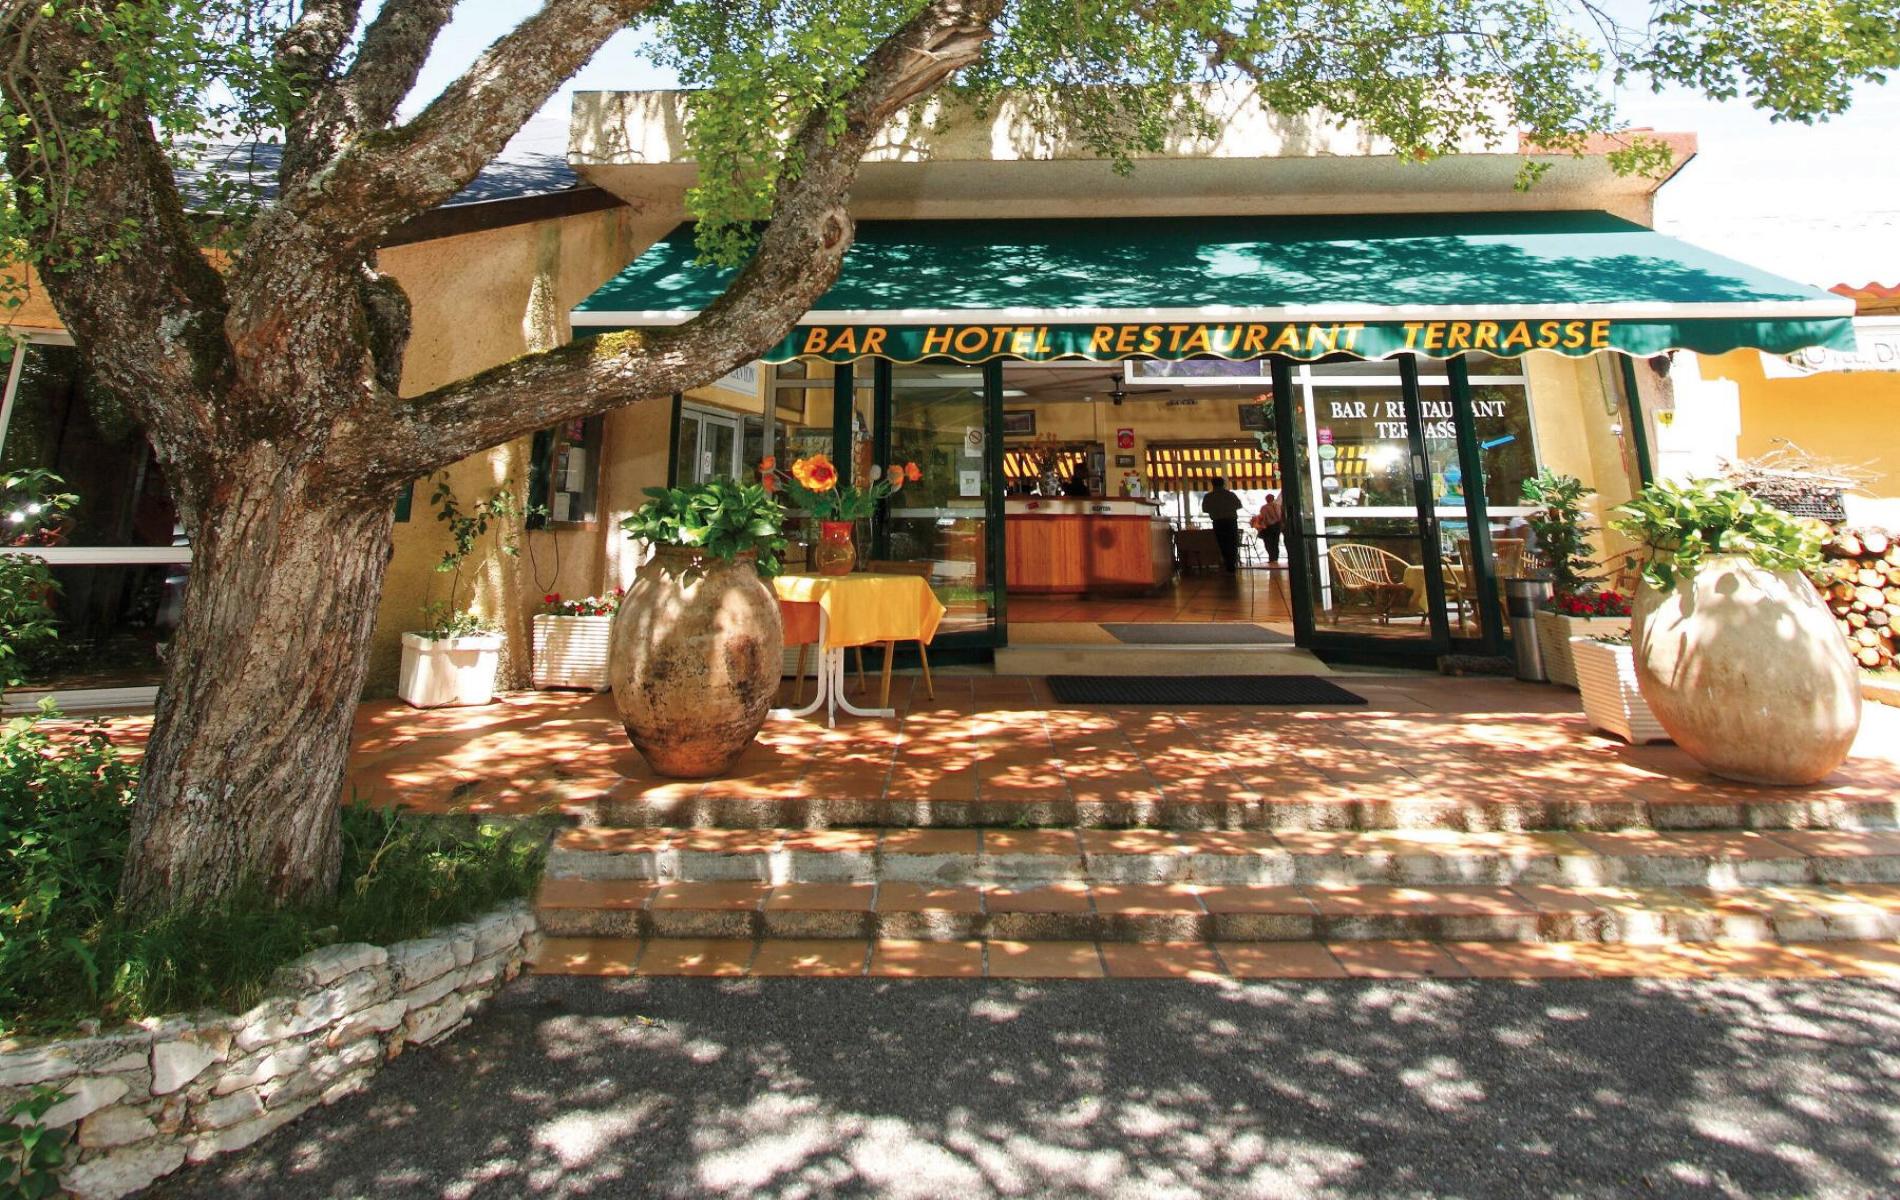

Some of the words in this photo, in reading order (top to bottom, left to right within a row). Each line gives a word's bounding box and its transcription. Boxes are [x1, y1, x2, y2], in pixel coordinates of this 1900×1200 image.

[803, 327, 888, 354] BAR
[921, 326, 1051, 353] HOTEL
[1088, 323, 1365, 353] RESTAURANT
[1403, 320, 1612, 350] TERRASSE
[1331, 401, 1367, 419] BAR
[1385, 400, 1506, 419] RETAUANT
[1375, 420, 1458, 439] TERASS
